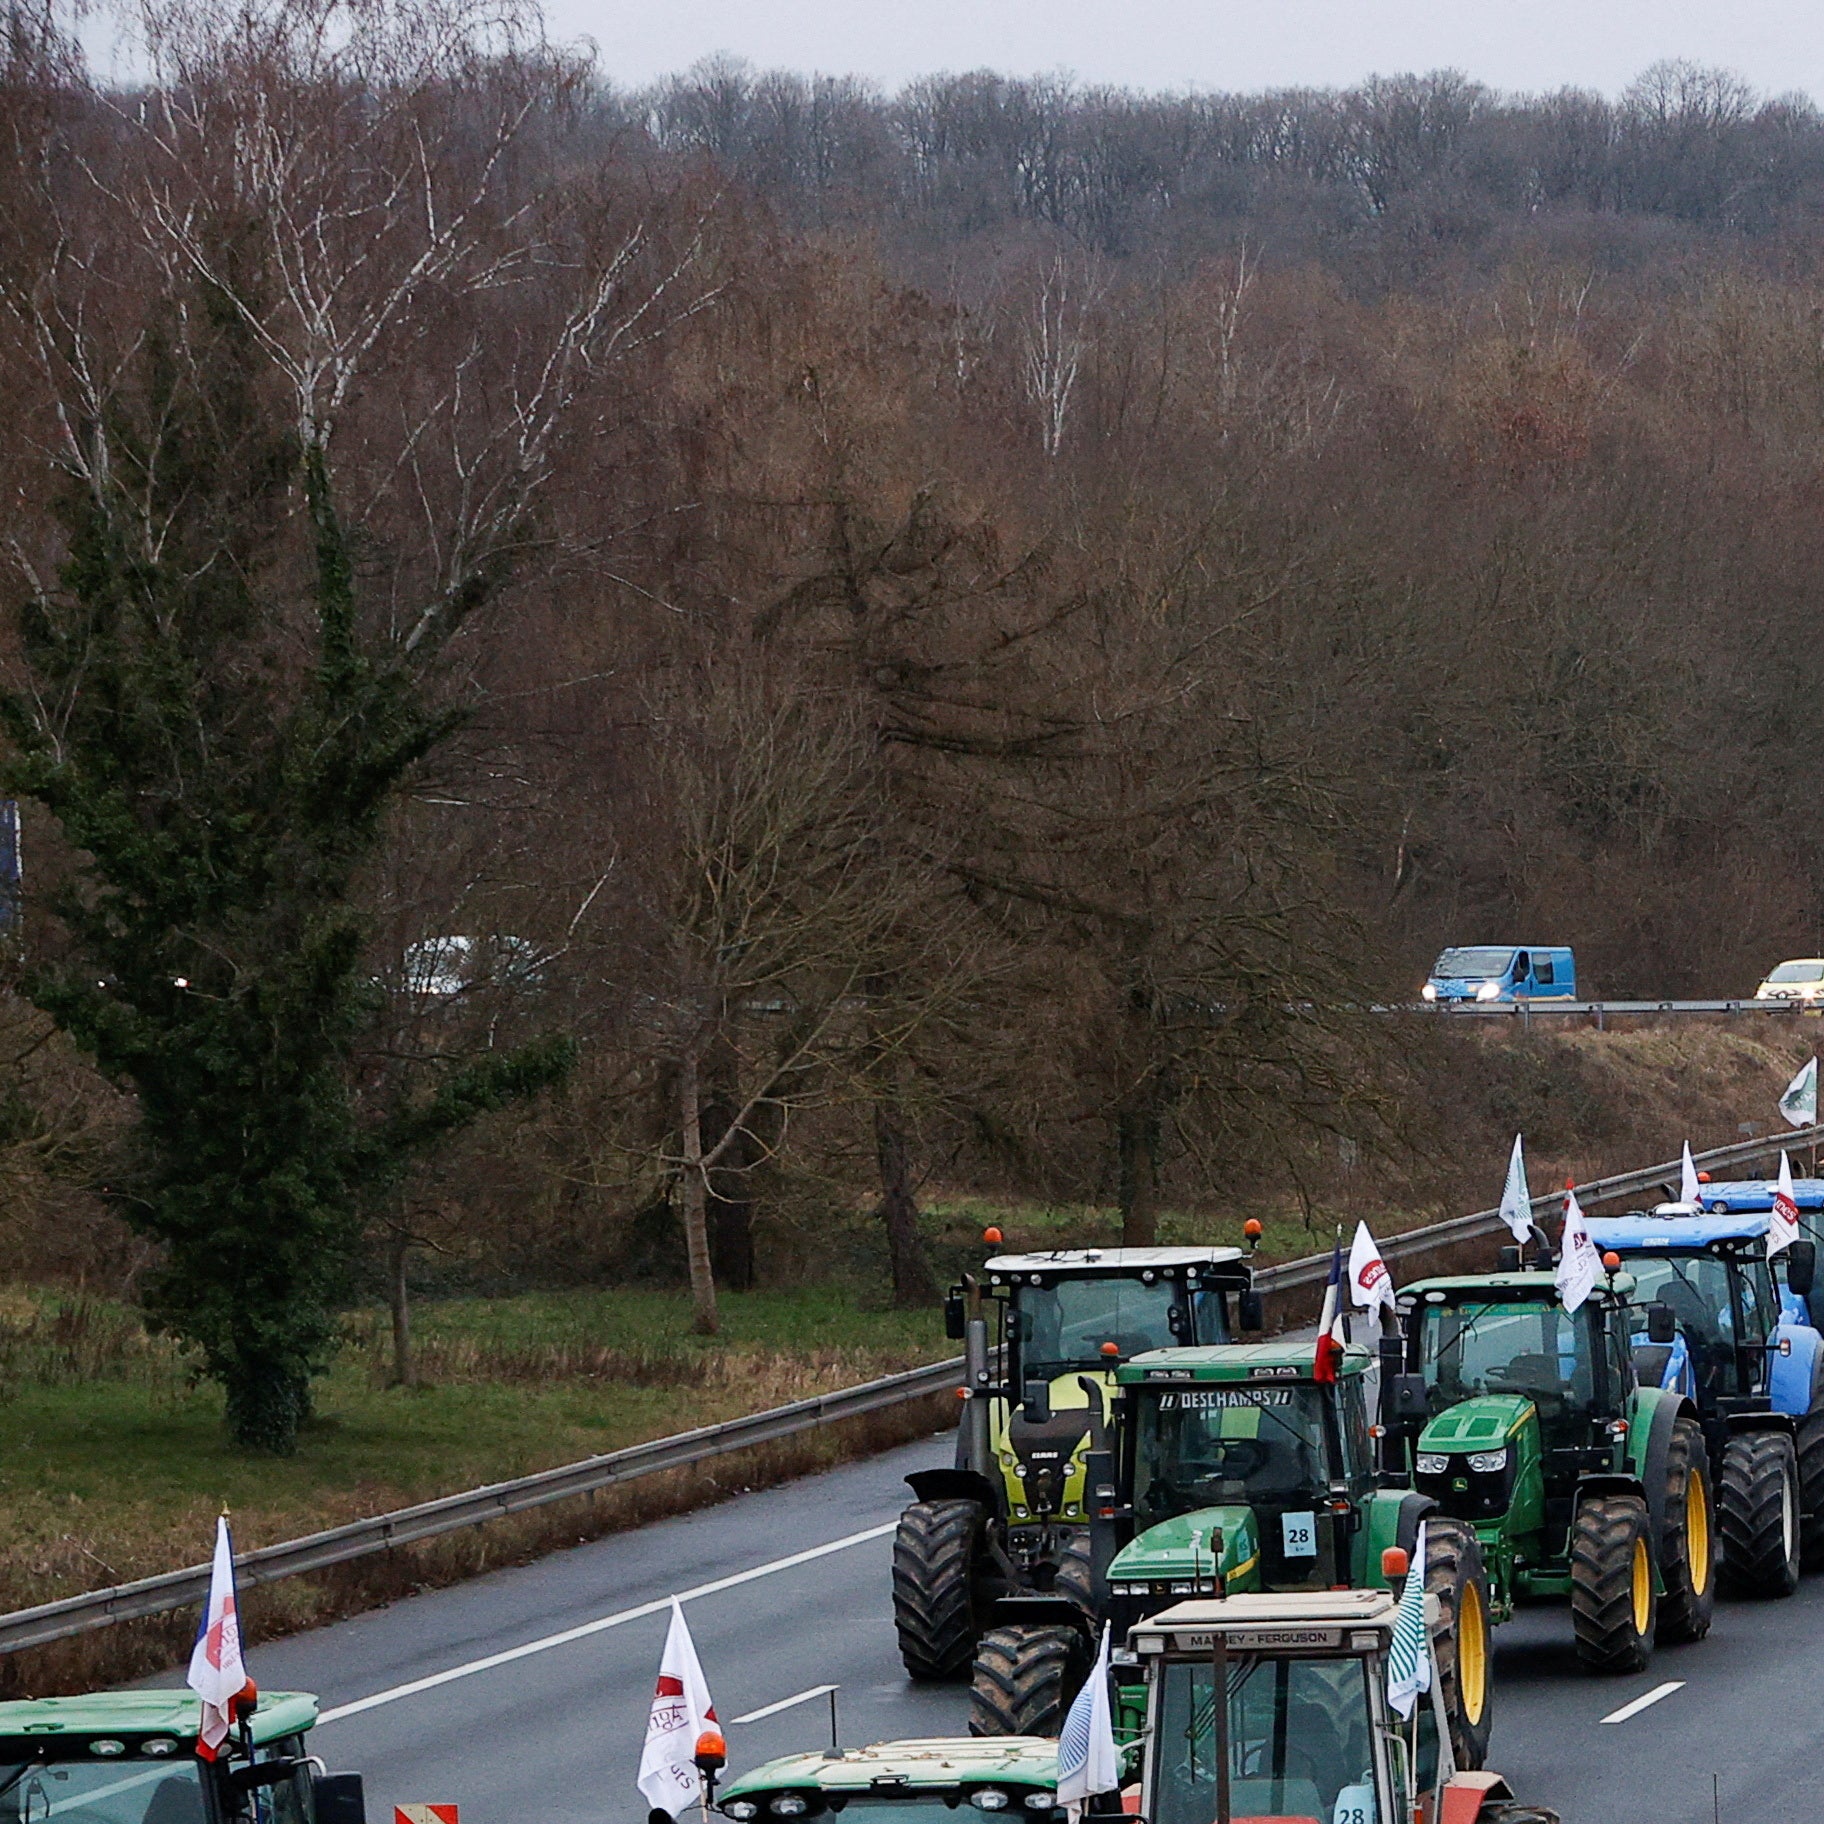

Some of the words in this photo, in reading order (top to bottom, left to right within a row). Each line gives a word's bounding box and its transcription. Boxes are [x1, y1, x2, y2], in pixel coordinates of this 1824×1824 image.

[1181, 1391, 1270, 1408] DESCHAMPS
[1288, 1528, 1309, 1544] 28
[1190, 1634, 1245, 1647] MAEY
[1257, 1632, 1327, 1644] FERGUSON
